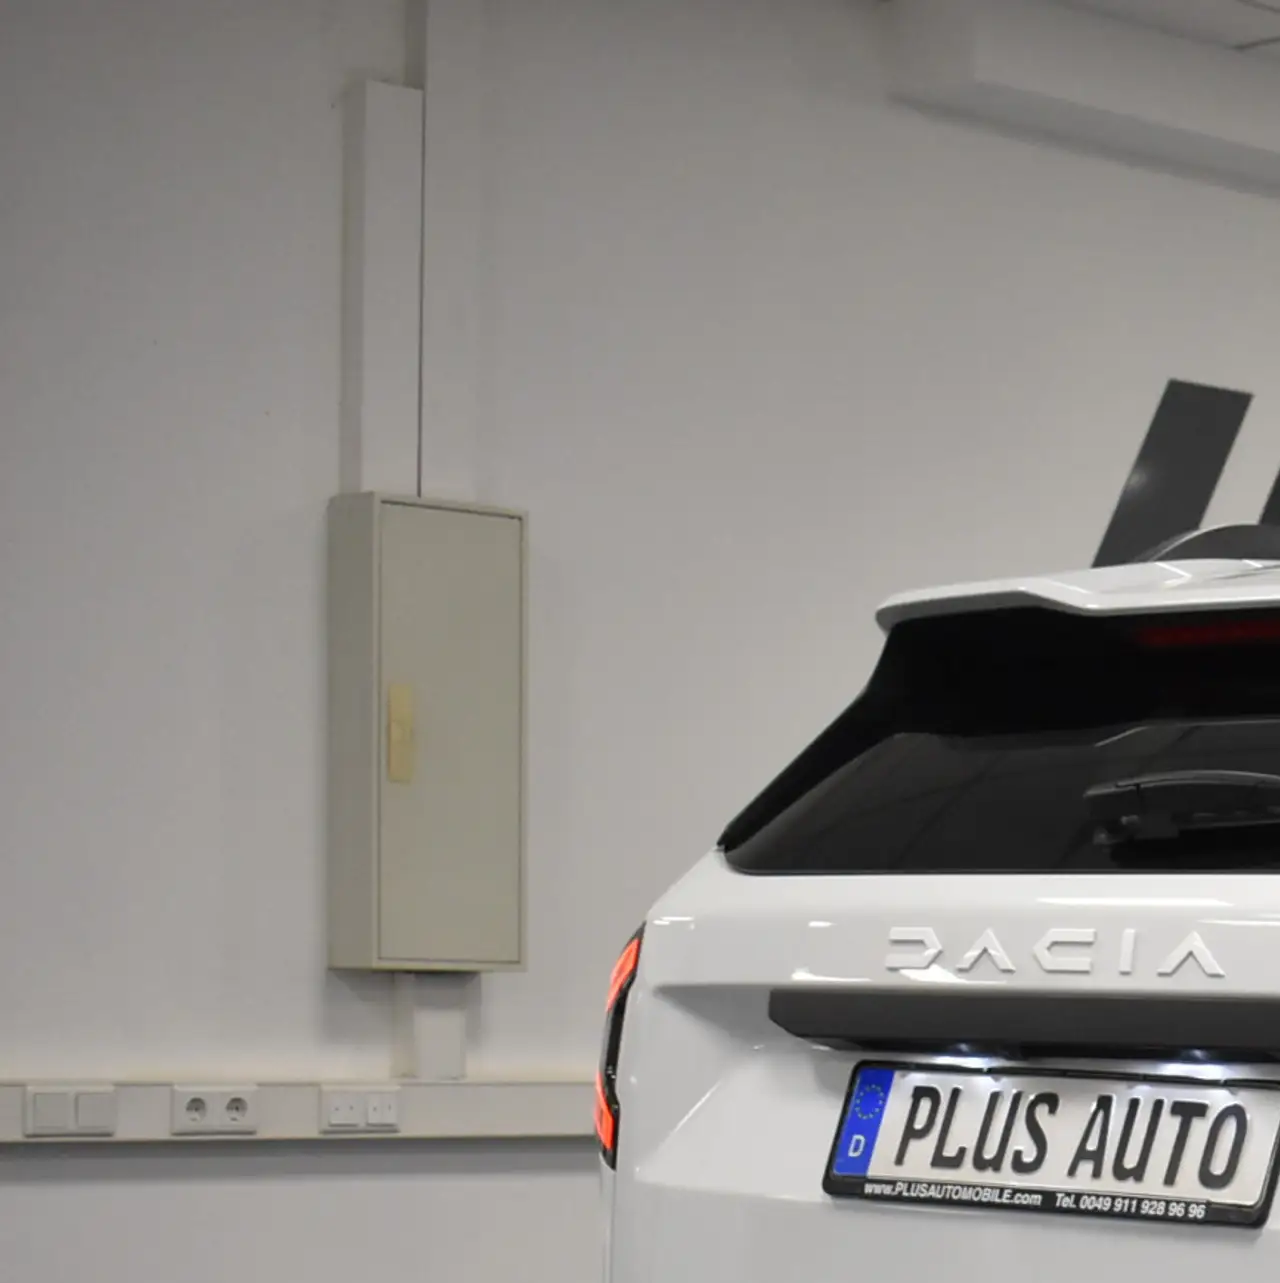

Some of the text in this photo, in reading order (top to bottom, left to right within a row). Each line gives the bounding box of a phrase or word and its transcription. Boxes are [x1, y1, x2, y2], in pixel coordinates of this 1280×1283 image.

[885, 926, 1226, 977] DACIA
[848, 1134, 866, 1158] D
[894, 1085, 1248, 1190] PLUS AUTO
[864, 1181, 1206, 1219] www.PLUSAUTOMOBILE.com Tel. 0049 911 928 96 96
